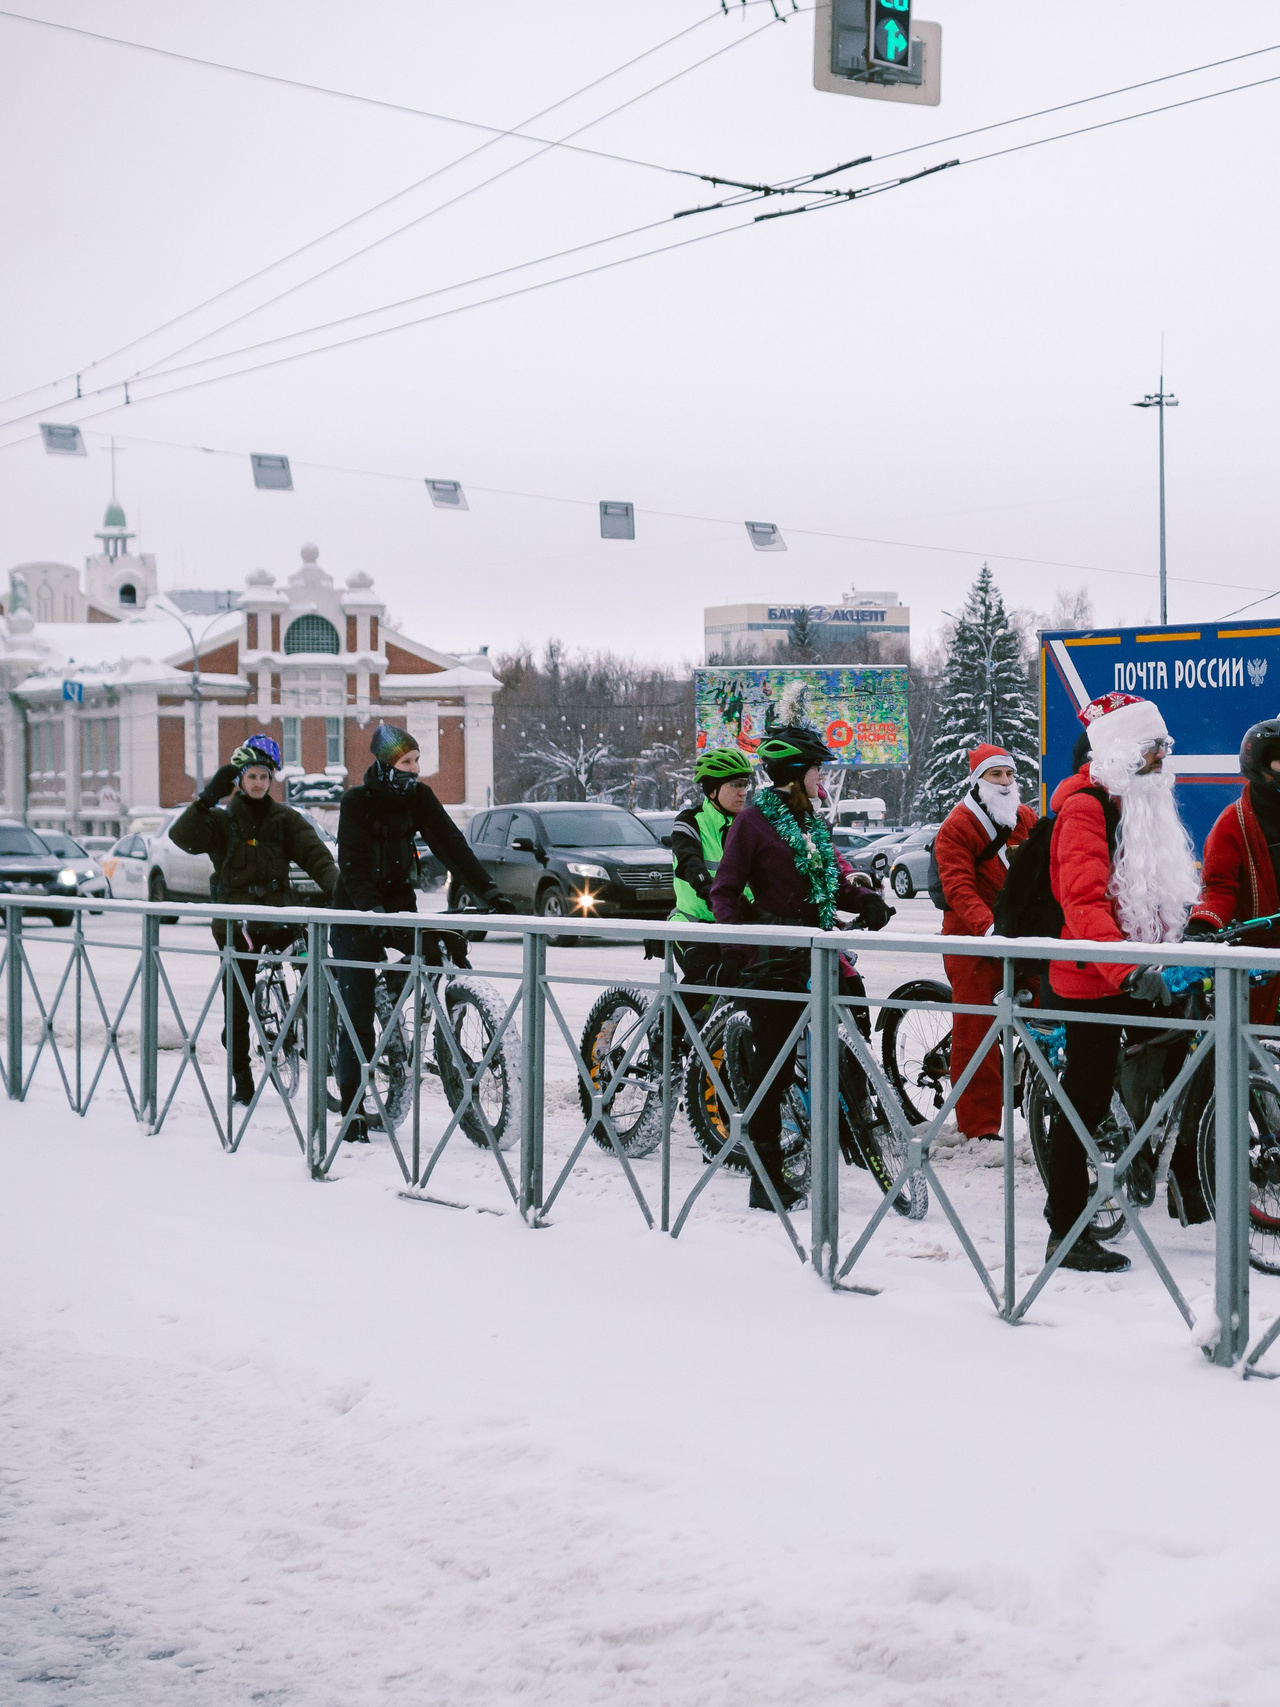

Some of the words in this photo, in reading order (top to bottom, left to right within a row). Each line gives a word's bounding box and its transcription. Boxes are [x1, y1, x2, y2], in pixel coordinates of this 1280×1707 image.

[832, 608, 887, 624] АКЦЕПТ
[1114, 660, 1168, 691] ПОЧТА
[1174, 656, 1244, 689] РОССИИ
[857, 733, 897, 742] мама
